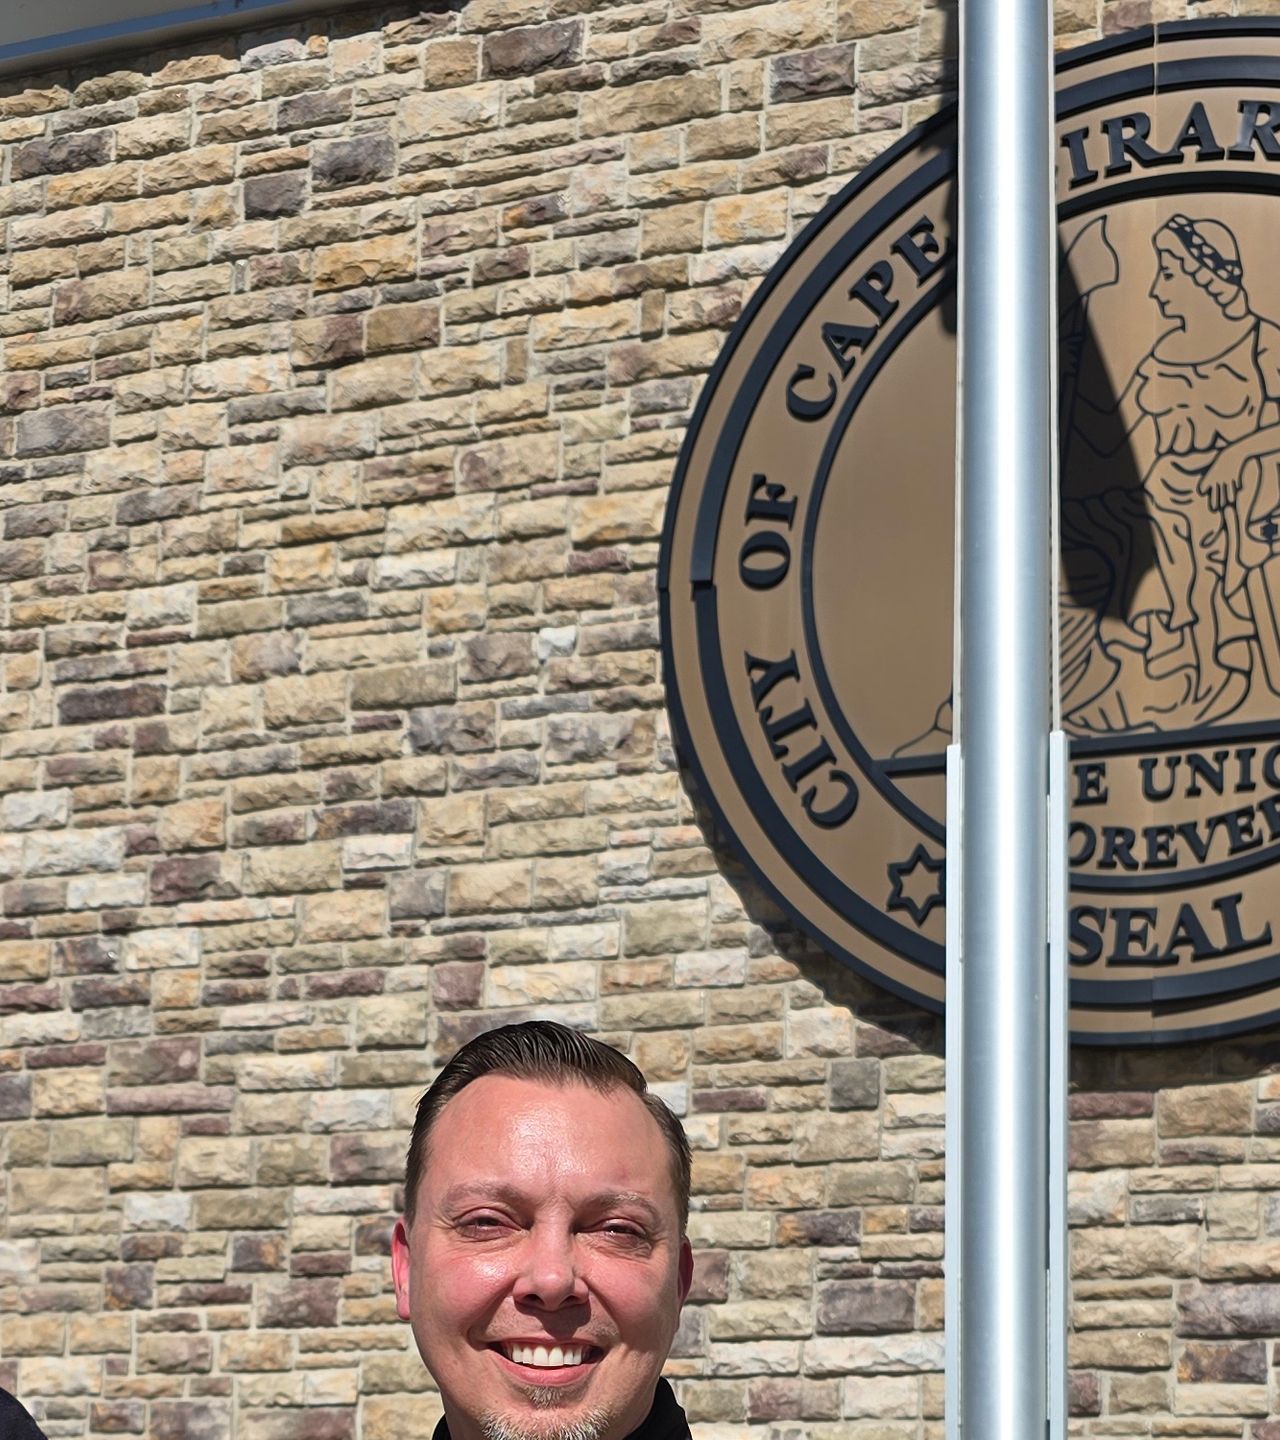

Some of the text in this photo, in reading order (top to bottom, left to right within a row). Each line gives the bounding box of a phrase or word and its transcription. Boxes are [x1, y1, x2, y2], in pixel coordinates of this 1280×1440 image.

[785, 214, 940, 423] CAPE
[738, 473, 799, 592] OF
[743, 648, 860, 831] CITY
[1067, 892, 1273, 969] SEAL
